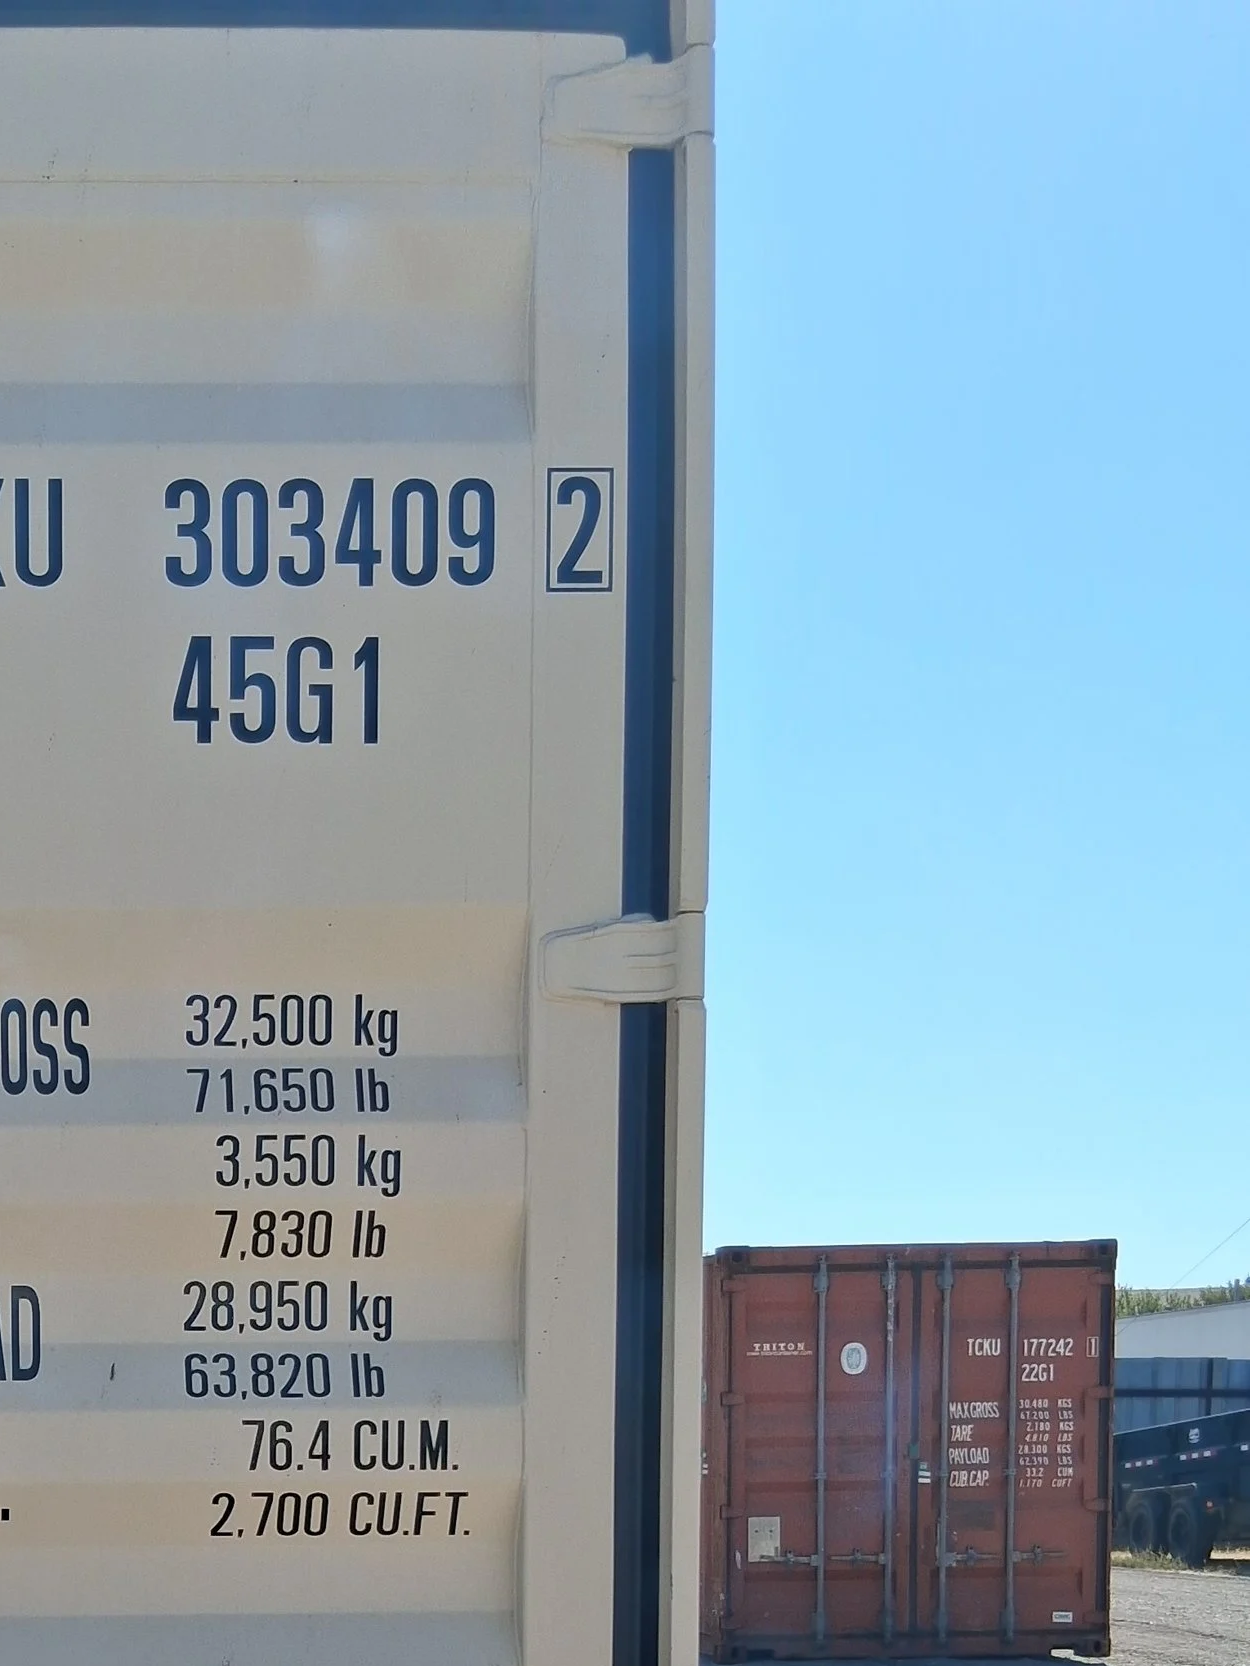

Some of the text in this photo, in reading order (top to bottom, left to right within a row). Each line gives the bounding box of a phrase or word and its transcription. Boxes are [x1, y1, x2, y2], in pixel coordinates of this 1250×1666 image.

[164, 477, 496, 588] 303409
[555, 475, 604, 585] 2
[172, 635, 379, 745] 45G1
[185, 993, 398, 1057] 32,500 kg
[186, 1067, 390, 1115] 71,650 lb
[215, 1134, 401, 1198] 3,550 kg
[214, 1210, 386, 1261] 7,830 lb
[183, 1280, 392, 1342] 28,950 kg
[967, 1338, 1001, 1356] TCKU
[1023, 1338, 1074, 1356] 177242
[184, 1352, 385, 1401] 63,820 lb
[1021, 1363, 1054, 1382] 22G1
[241, 1419, 459, 1471] 76.4 CU.M.
[949, 1447, 990, 1464] PAYLOAD
[950, 1424, 974, 1442] TARE
[210, 1491, 470, 1538] 2,700 CU.FT.
